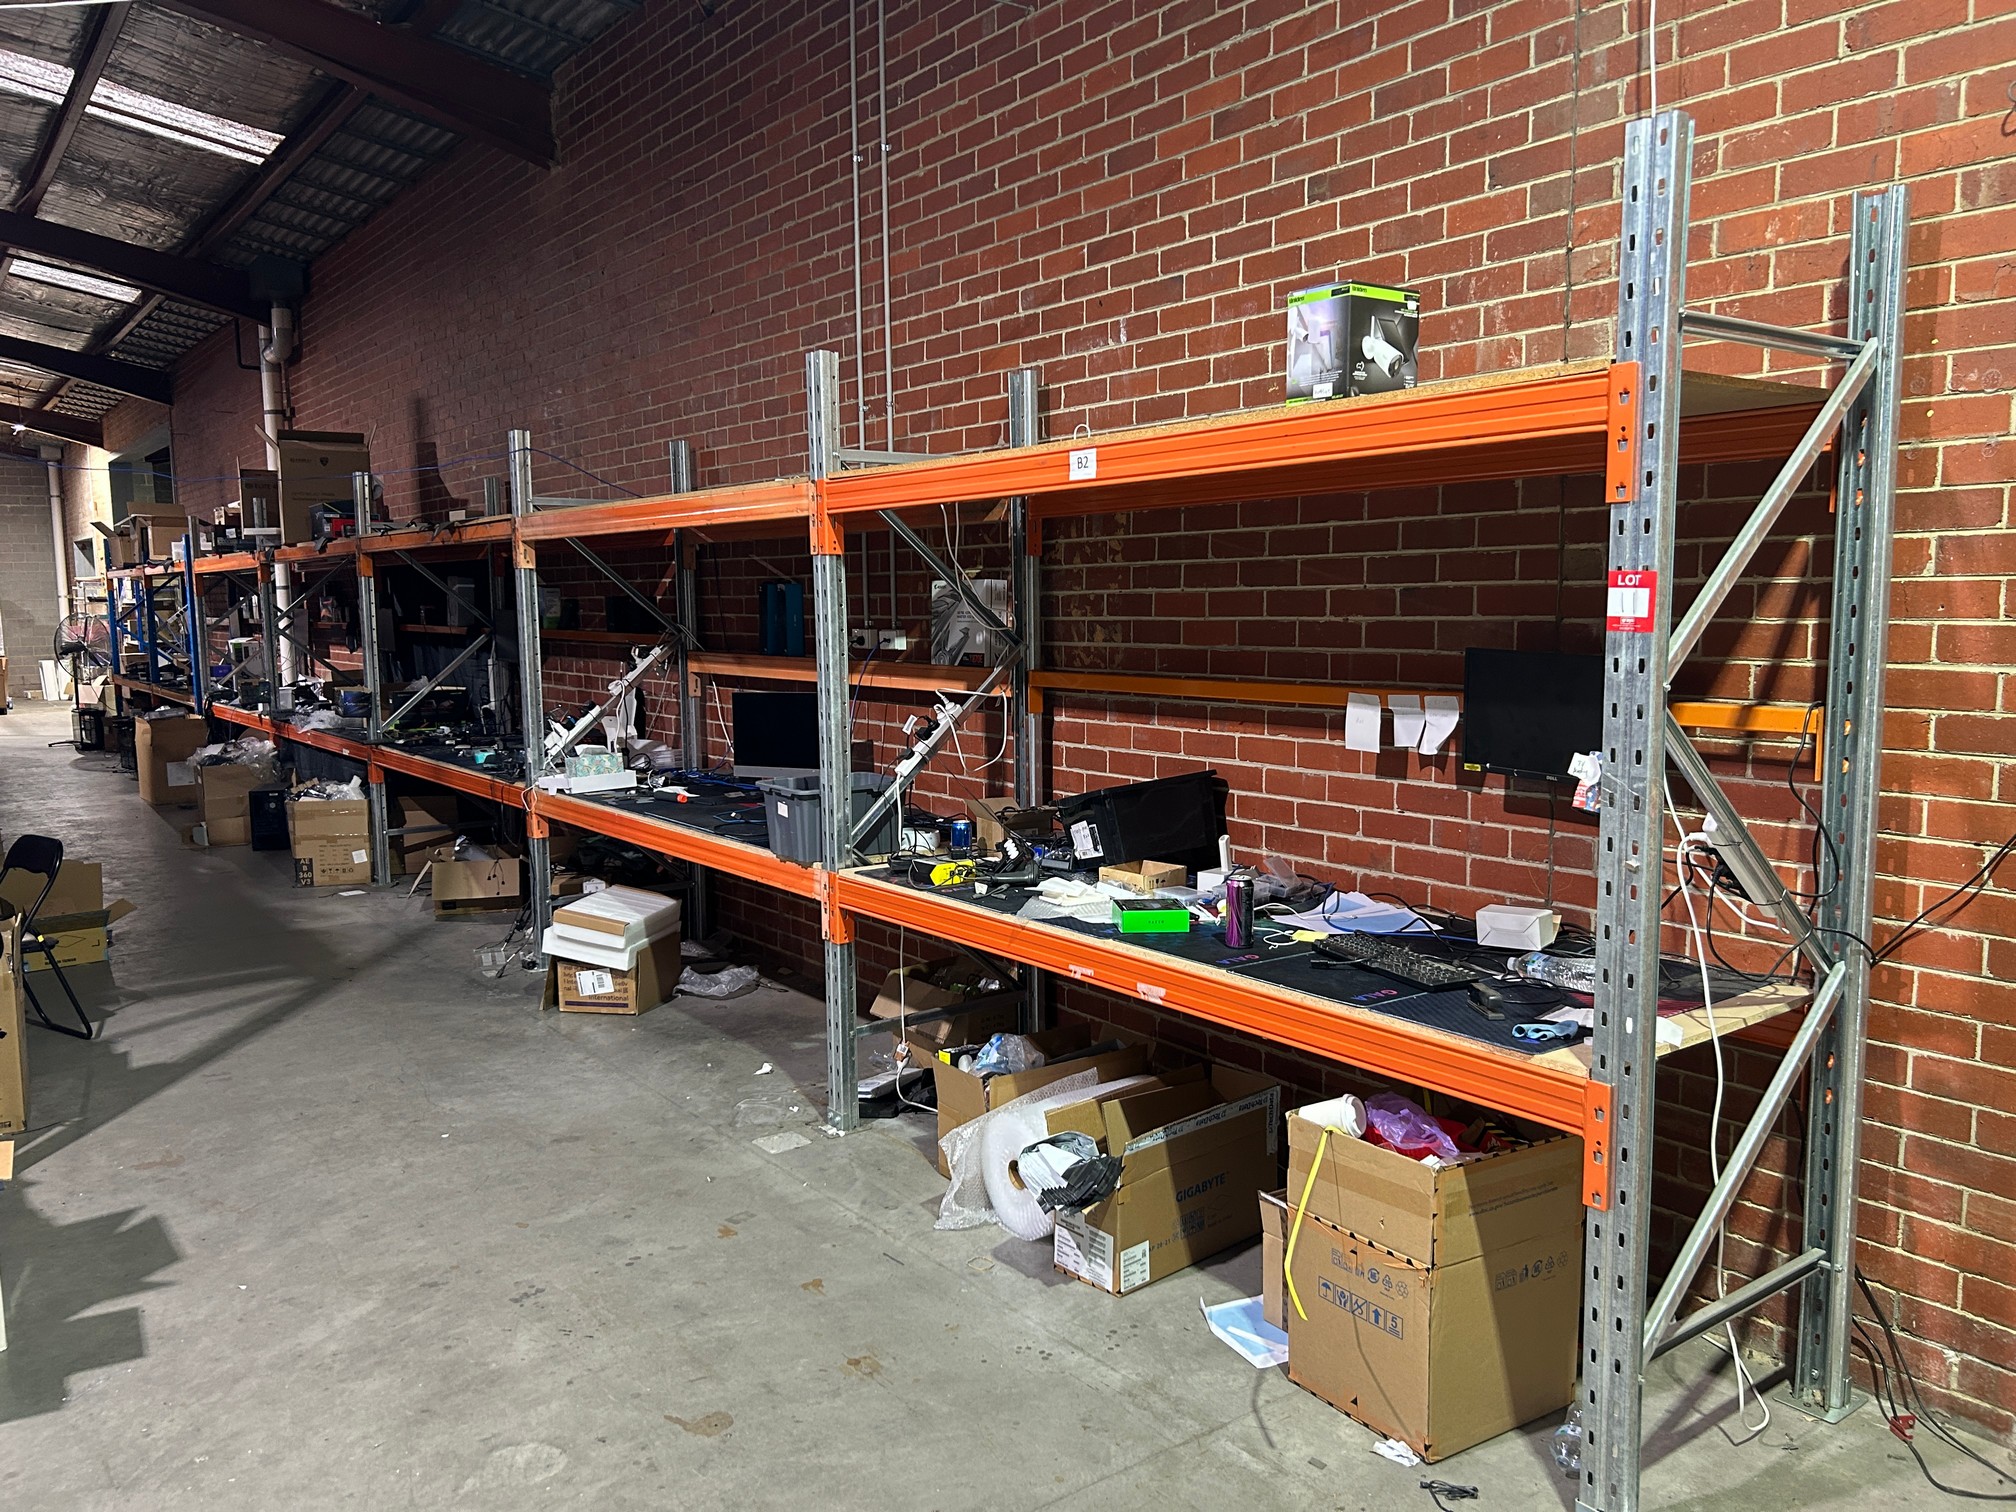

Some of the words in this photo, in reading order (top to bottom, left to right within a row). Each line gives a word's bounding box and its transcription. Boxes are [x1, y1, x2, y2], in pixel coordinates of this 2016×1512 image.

[1077, 456, 1089, 469] B2
[1617, 574, 1642, 586] LOT
[299, 871, 313, 879] 360
[1176, 1173, 1226, 1202] GIGABYTE
[1391, 1316, 1398, 1329] 5
